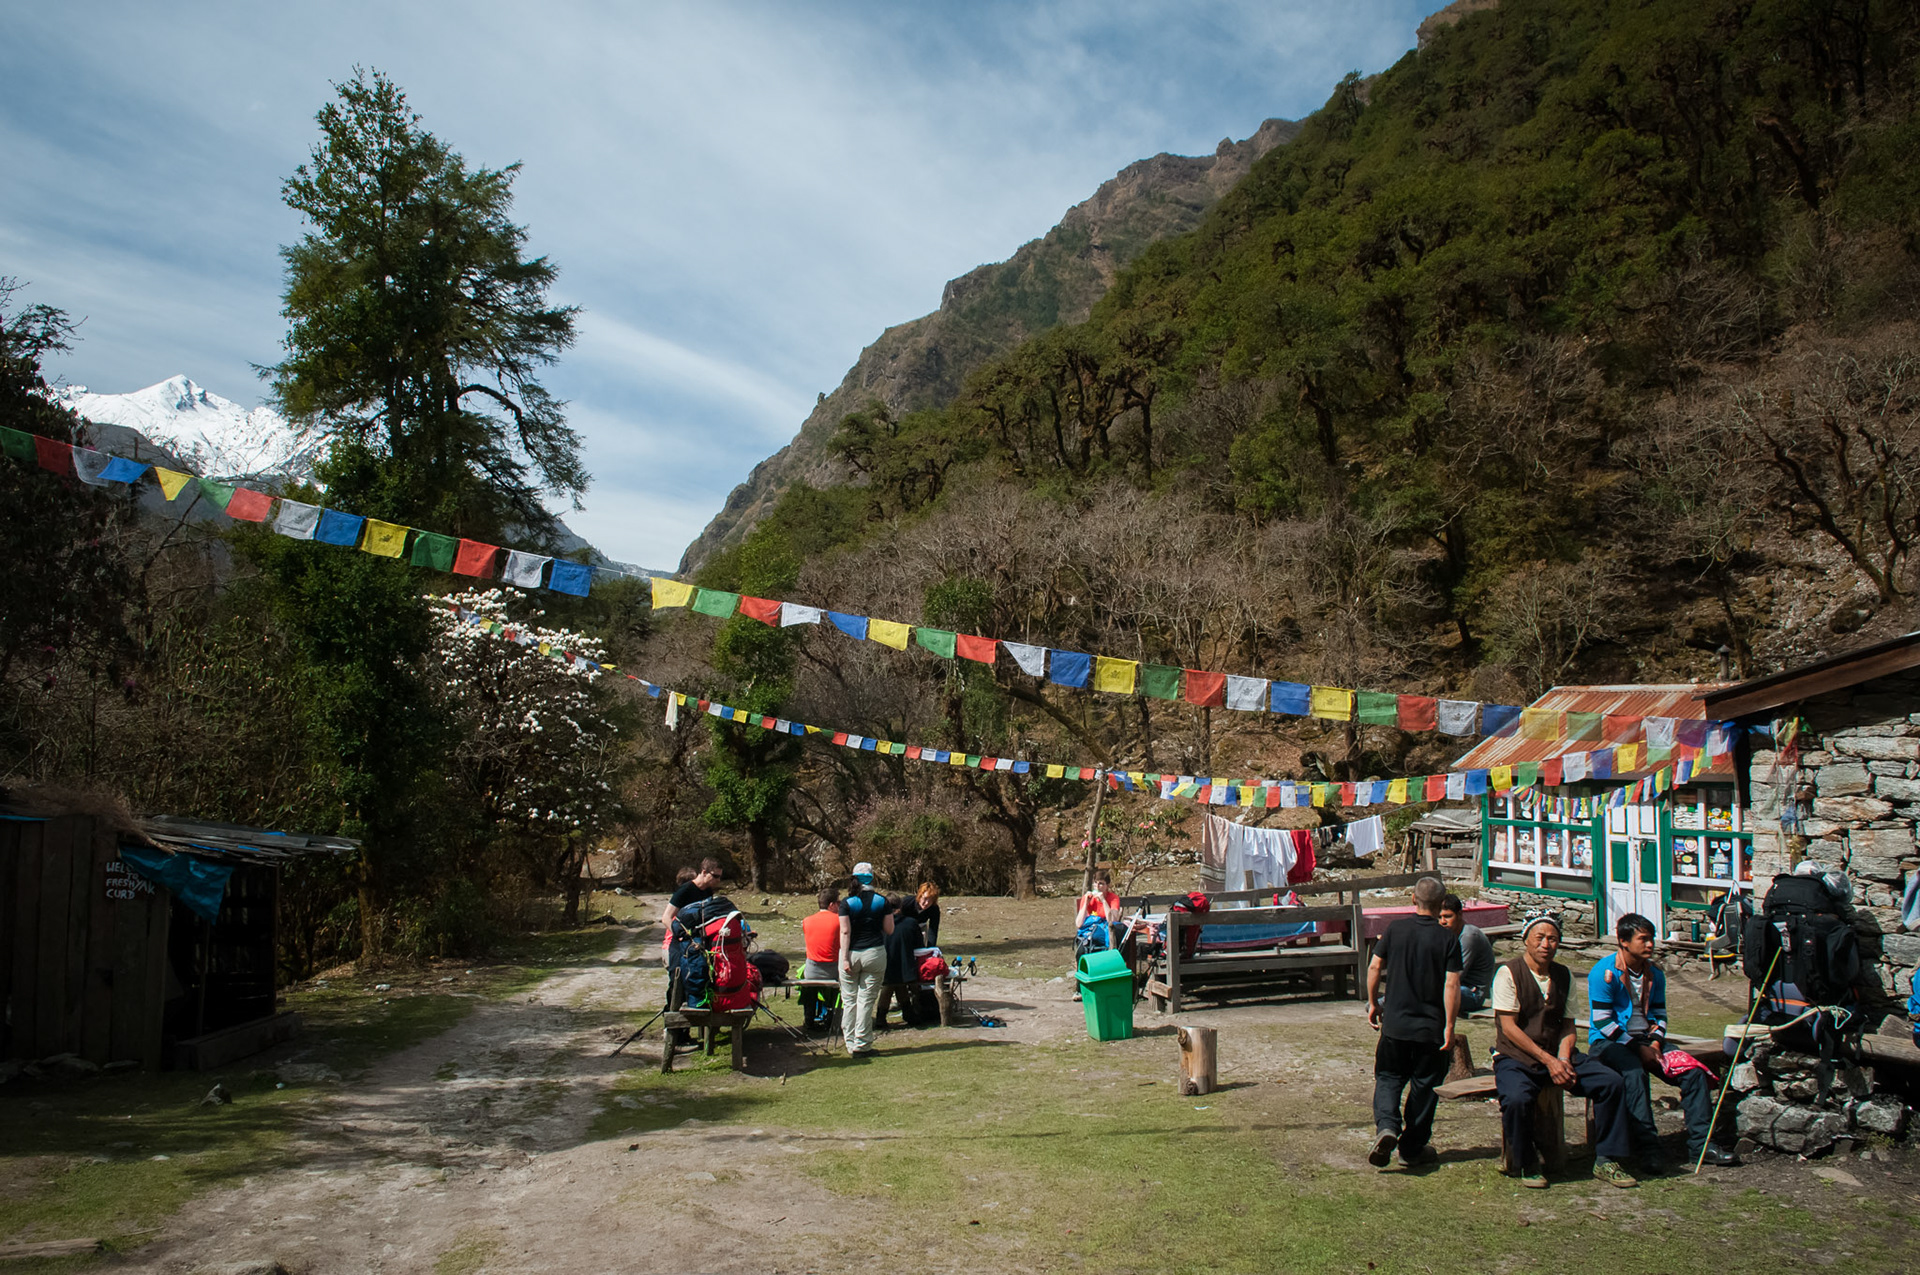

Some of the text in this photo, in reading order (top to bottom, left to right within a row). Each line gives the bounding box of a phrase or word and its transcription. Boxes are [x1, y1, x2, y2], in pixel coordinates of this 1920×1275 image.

[126, 872, 139, 880] TO
[106, 878, 156, 895] FRESH YAK
[106, 889, 135, 899] CURD
